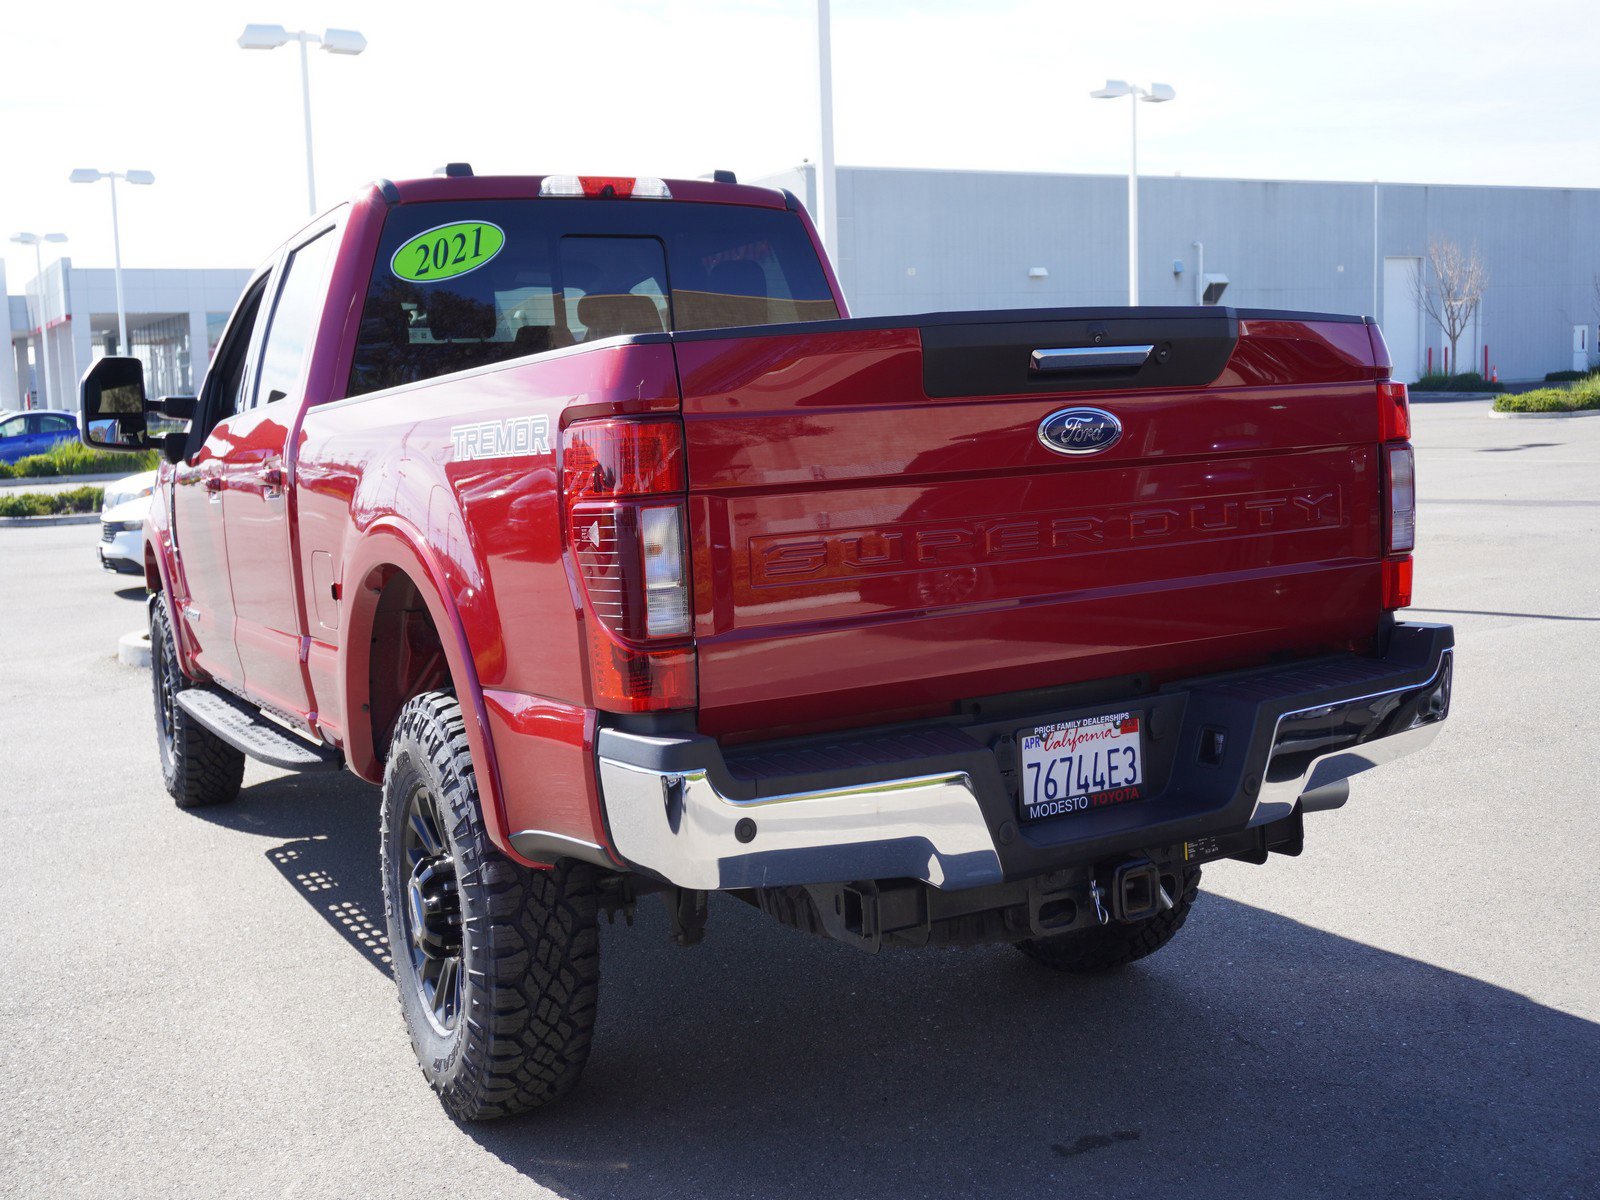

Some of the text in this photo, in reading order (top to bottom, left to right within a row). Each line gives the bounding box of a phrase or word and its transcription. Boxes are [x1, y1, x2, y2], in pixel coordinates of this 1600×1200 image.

[414, 225, 483, 277] 2021
[451, 414, 551, 461] TREMOR
[1060, 416, 1105, 443] Ford
[762, 493, 1333, 577] SUPER DUTY
[1024, 728, 1121, 753] APR California
[1034, 724, 1055, 735] PRICE
[1056, 719, 1082, 731] FAMILY
[1082, 712, 1130, 727] DEALERSHIPS
[1026, 746, 1138, 803] 76744E3
[1029, 787, 1140, 819] MODESTO TOYOTA
